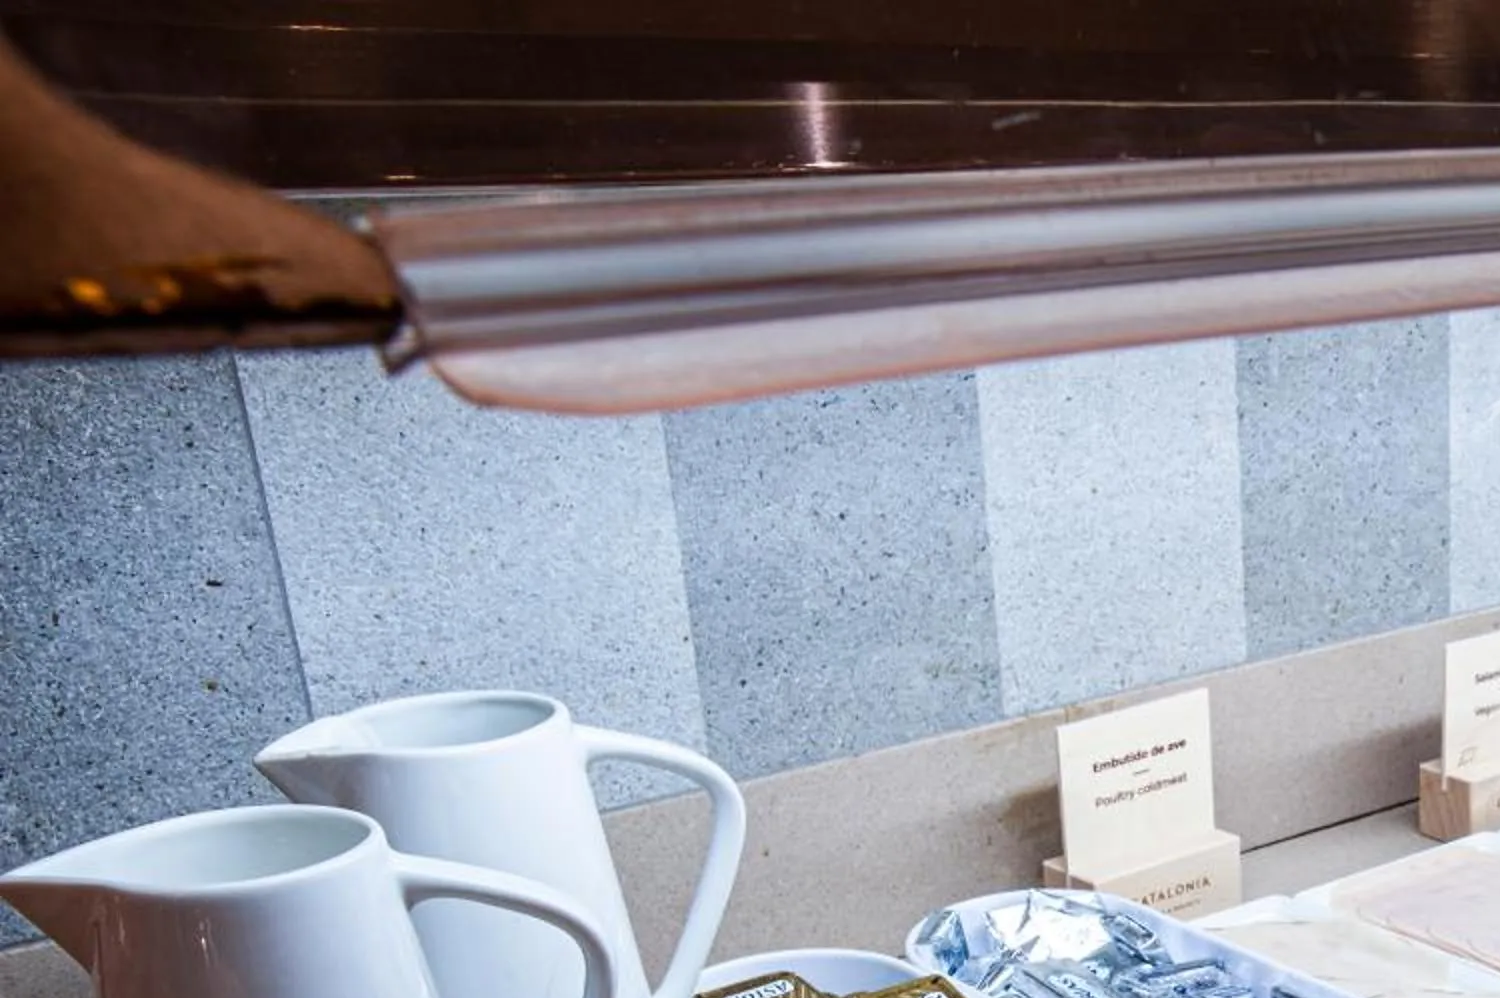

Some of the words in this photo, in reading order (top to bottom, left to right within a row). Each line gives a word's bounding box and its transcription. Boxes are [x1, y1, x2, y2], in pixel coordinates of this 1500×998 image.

[1092, 750, 1148, 774] Embutido
[1151, 745, 1165, 756] de
[1167, 739, 1187, 752] ave
[1095, 788, 1135, 809] Poultry
[1137, 772, 1188, 795] coldmeat
[1131, 876, 1212, 905] ATALONIA
